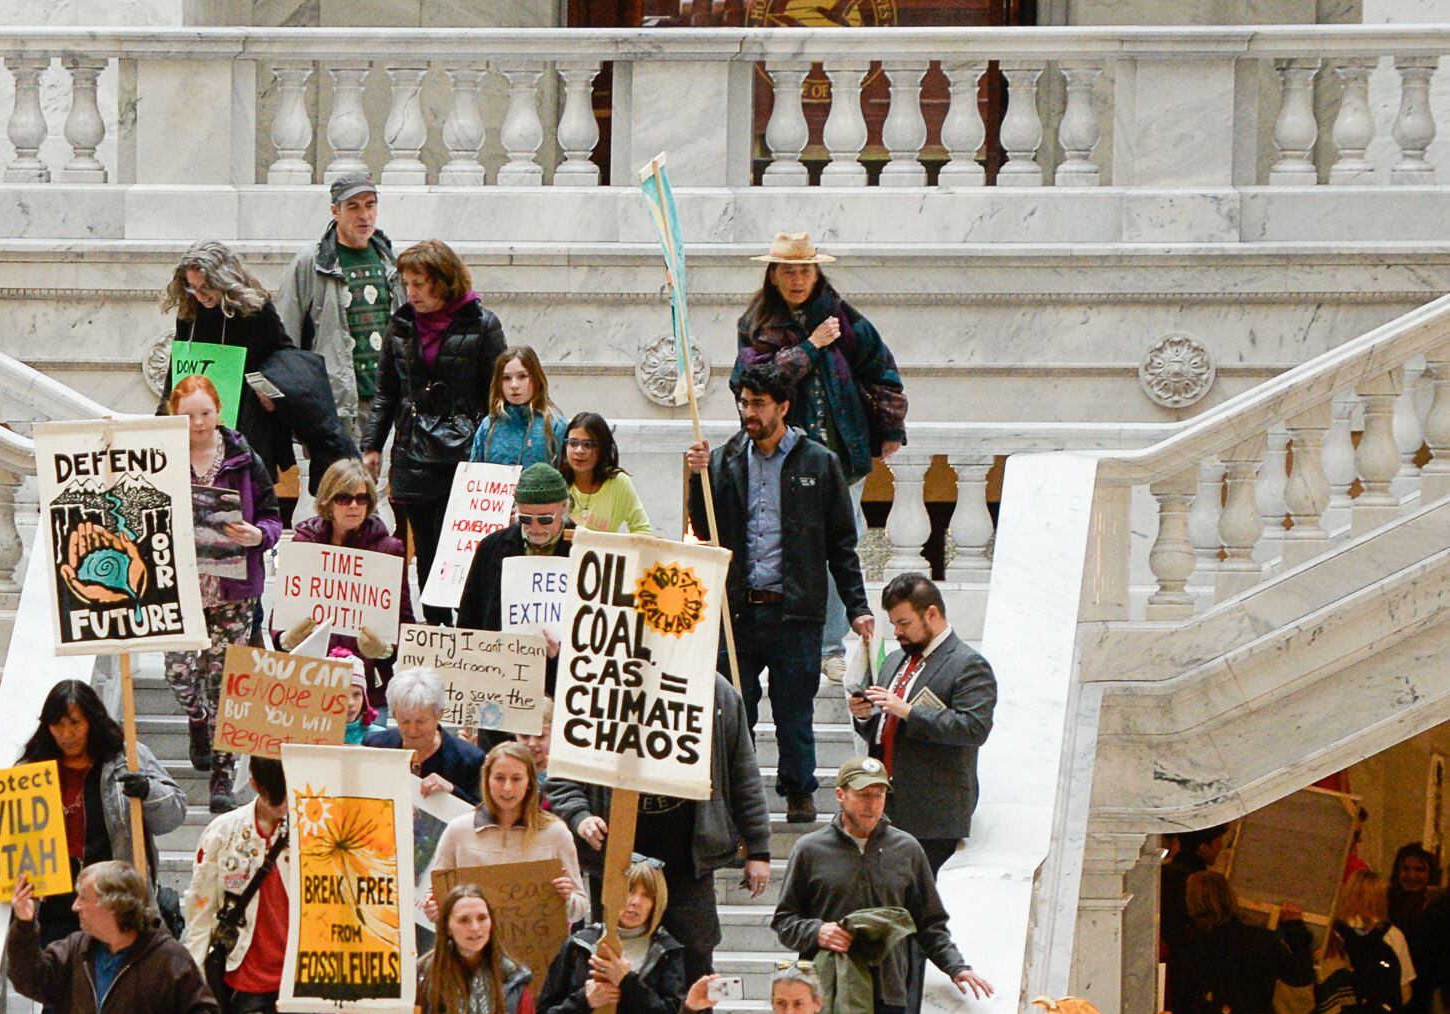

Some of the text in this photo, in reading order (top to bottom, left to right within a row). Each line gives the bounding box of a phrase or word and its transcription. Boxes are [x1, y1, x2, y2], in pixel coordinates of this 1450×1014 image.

[54, 447, 168, 484] DEFEND
[456, 538, 481, 552] LAT
[151, 532, 175, 590] OUR
[321, 550, 364, 577] TIME
[285, 575, 392, 610] IS RUNNING
[532, 572, 568, 594] RES
[69, 601, 183, 641] FUTURE
[312, 603, 363, 631] OUT!!
[508, 602, 562, 625] EXTIN
[405, 629, 457, 659] sorry
[461, 631, 474, 651] I
[508, 639, 546, 657] clean
[252, 649, 296, 680] YOU
[403, 654, 531, 682] my bedroom, I
[570, 655, 644, 688] GAS
[445, 681, 536, 708] to save the
[565, 684, 704, 734] CLIMATE
[224, 698, 253, 720] BUT
[264, 704, 295, 727] YOU
[563, 717, 701, 765] CHAOS
[304, 875, 395, 906] BREAK FREE
[331, 924, 363, 943] FROM
[299, 951, 399, 984] FOSSIL FUELS
